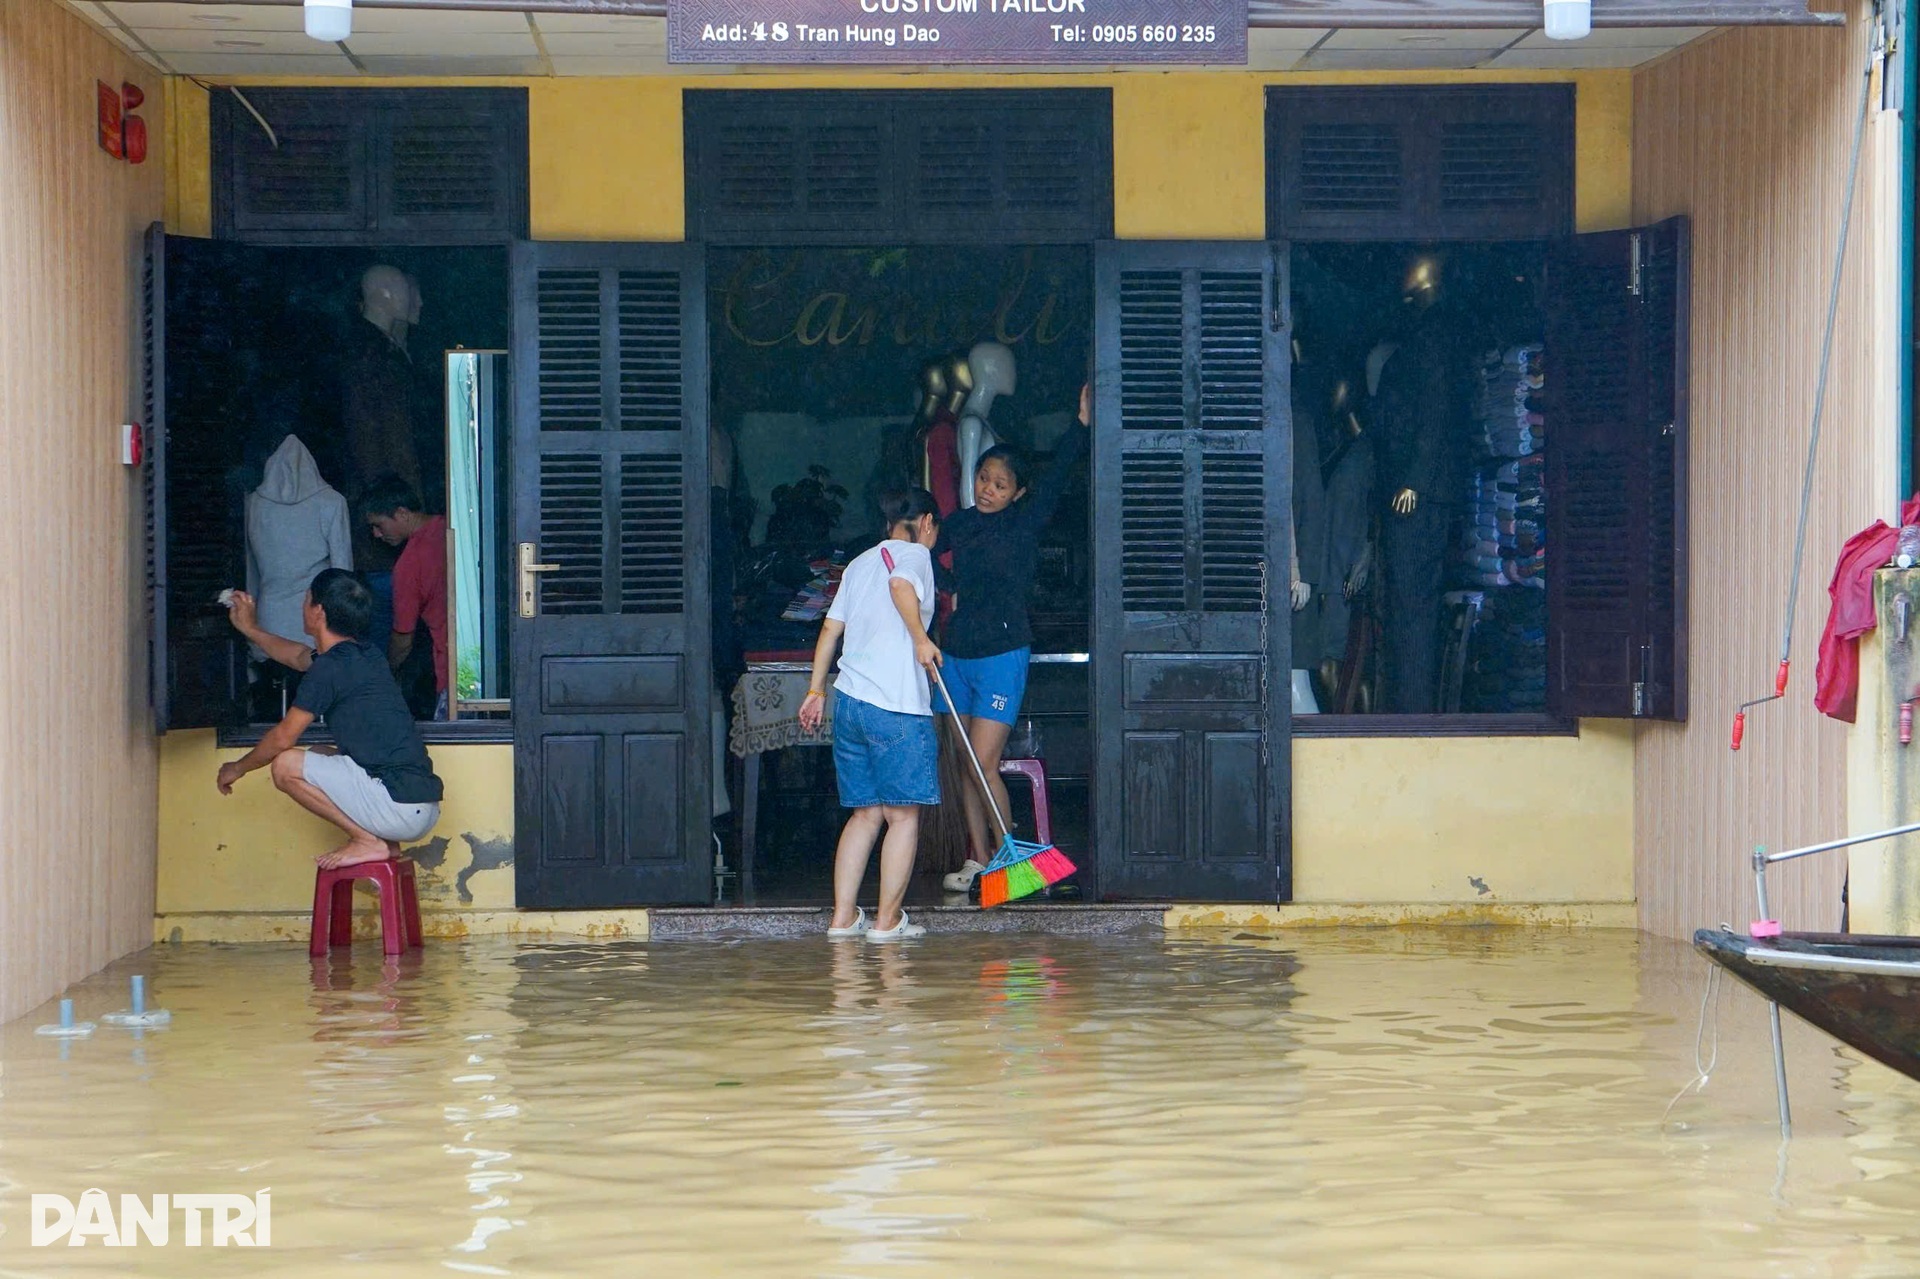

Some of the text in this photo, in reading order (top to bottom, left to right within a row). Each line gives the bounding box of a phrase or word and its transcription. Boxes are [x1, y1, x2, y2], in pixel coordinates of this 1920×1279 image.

[860, 0, 1086, 13] CUSTOM TAILOR
[701, 21, 940, 46] Add: 48 Tran Hung Dao
[1050, 24, 1216, 42] Tel: 0905 660 235
[991, 699, 1005, 711] 49
